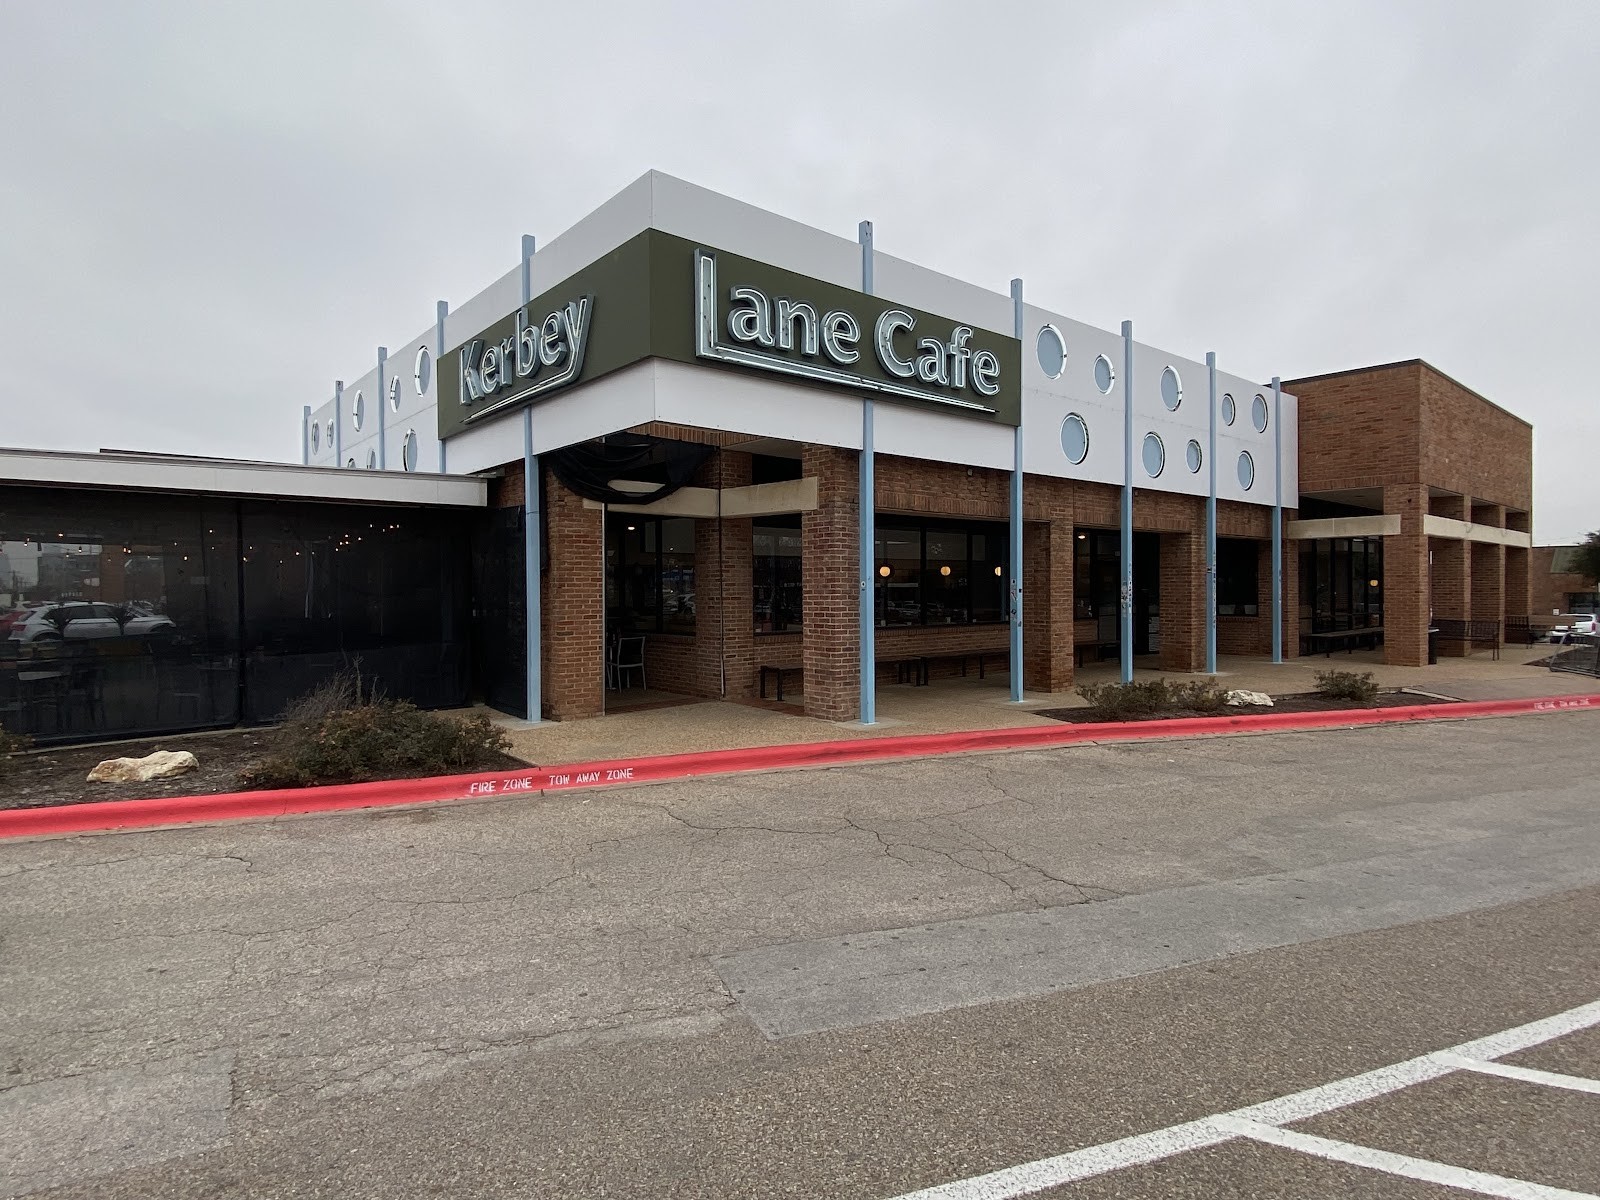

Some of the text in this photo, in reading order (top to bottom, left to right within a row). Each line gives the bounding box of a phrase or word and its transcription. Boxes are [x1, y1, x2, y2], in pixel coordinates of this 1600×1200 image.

[459, 293, 595, 422] Kerbey
[693, 247, 1000, 396] Lane Cafe
[470, 767, 634, 794] FIRE ZONE TOW AWAY ZONE
